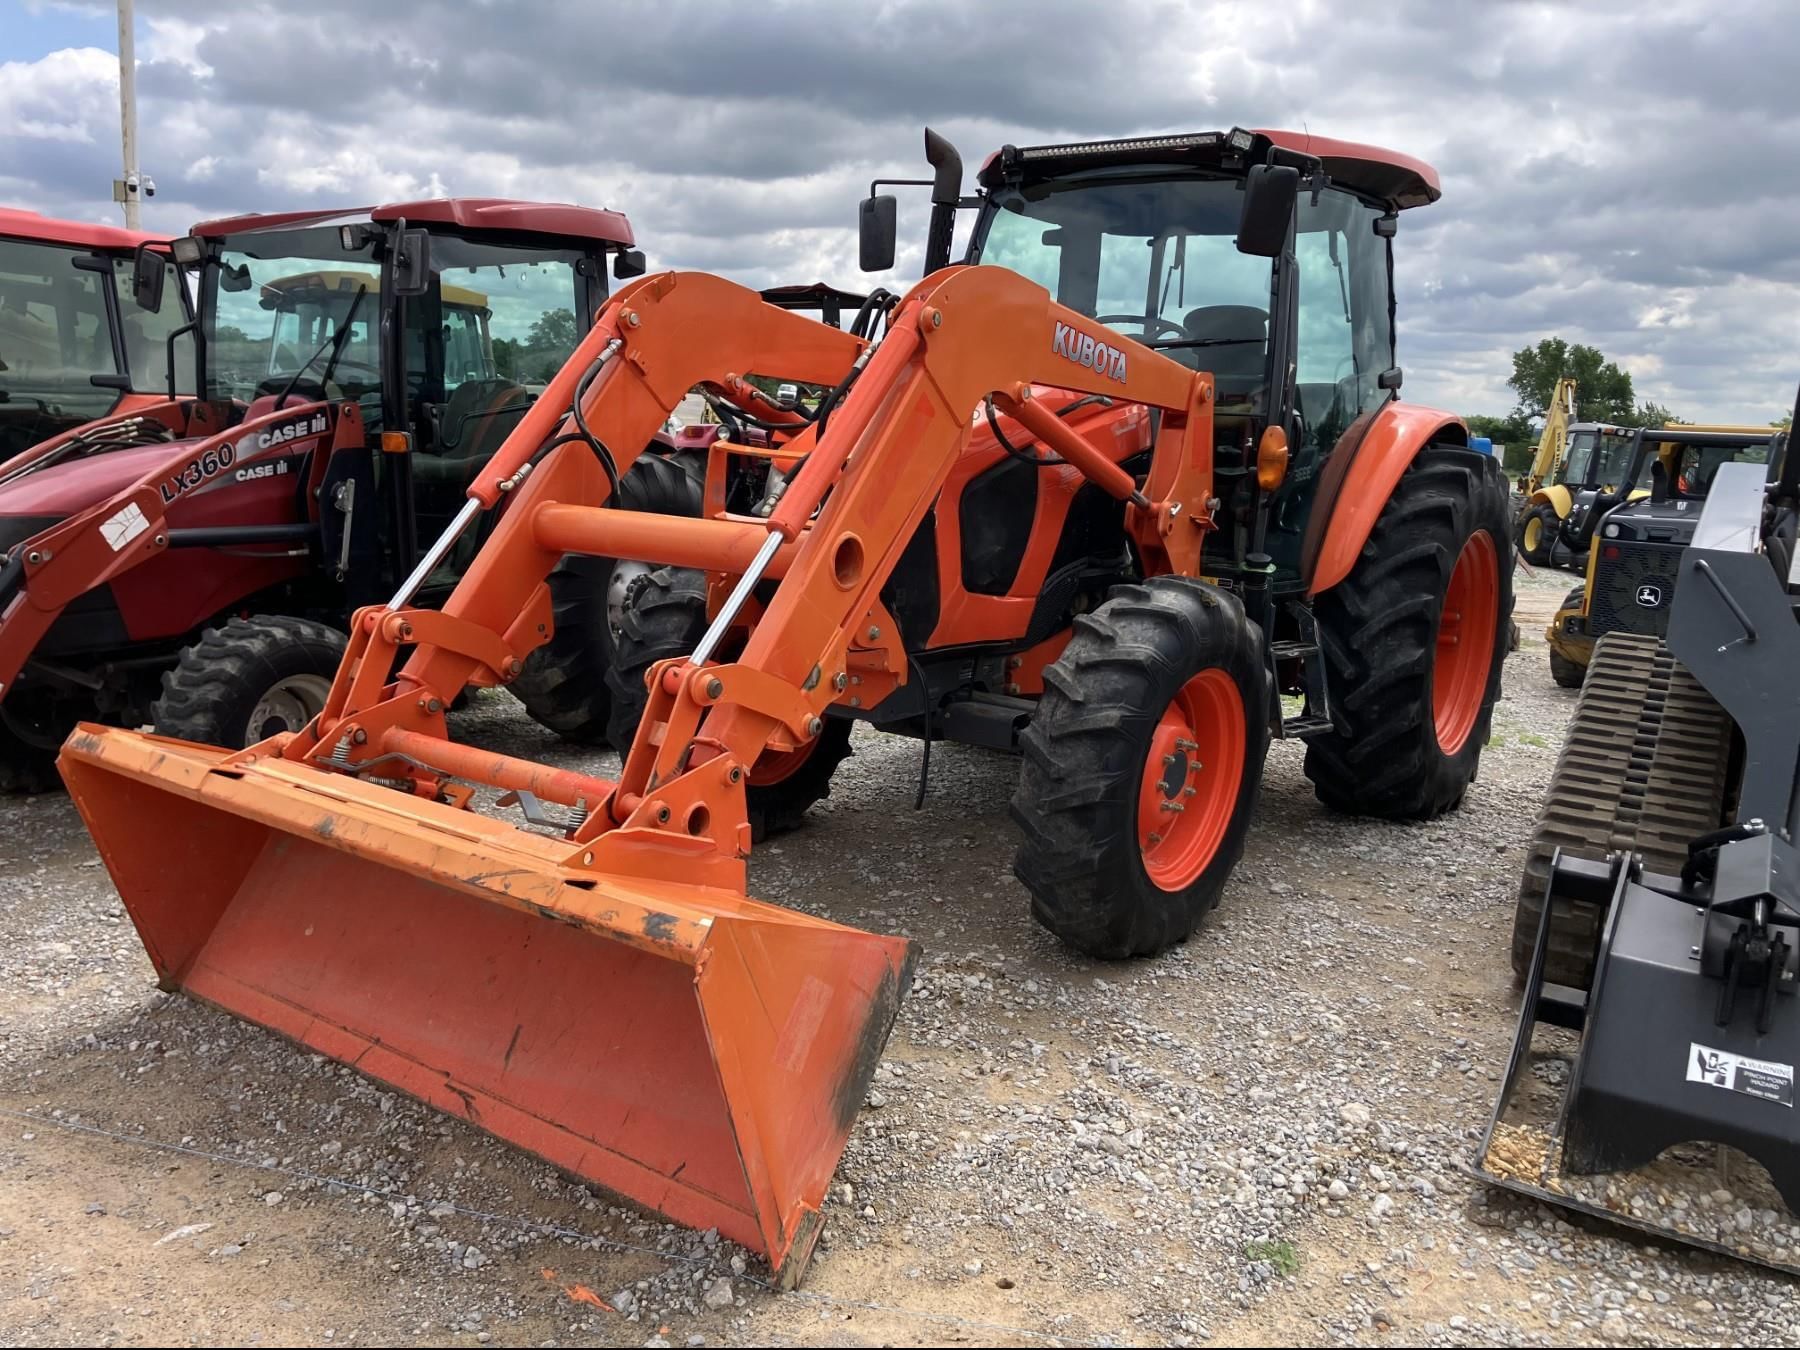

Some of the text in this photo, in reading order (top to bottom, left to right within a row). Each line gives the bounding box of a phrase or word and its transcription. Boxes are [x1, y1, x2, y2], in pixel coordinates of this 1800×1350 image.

[1052, 320, 1127, 384] KUBOTA
[159, 442, 236, 504] LX360
[258, 421, 308, 449] CASE
[235, 465, 274, 482] CASE
[1743, 1070, 1788, 1086] PINCH POINT
[1750, 1078, 1780, 1090] HAZARD
